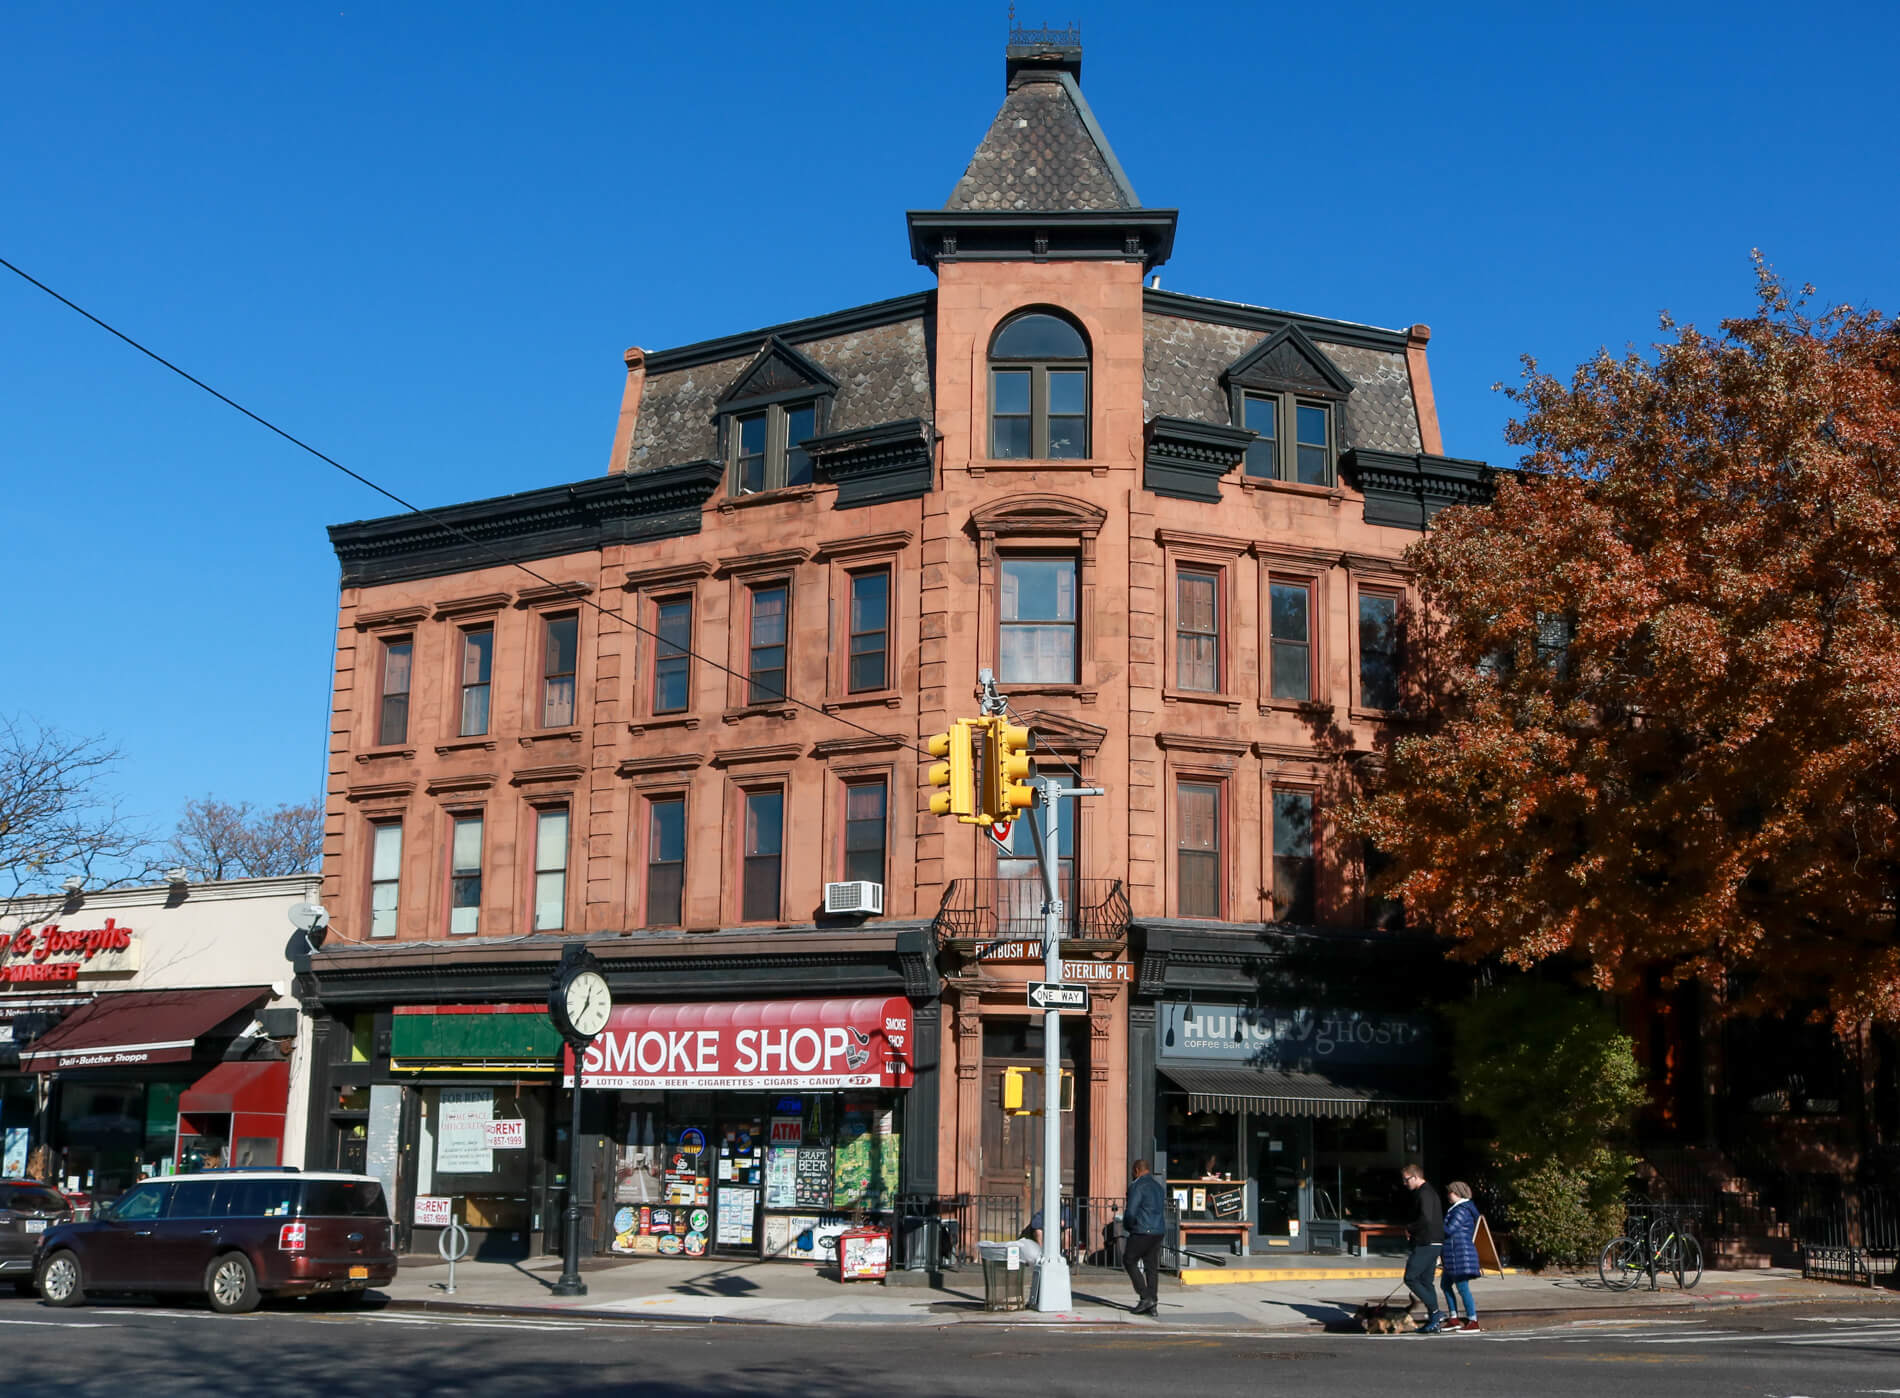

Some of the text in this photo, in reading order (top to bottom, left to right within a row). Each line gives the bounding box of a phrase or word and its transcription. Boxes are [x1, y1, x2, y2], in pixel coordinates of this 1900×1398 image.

[12, 928, 36, 952] &
[34, 918, 132, 960] Josephs
[975, 943, 1023, 959] FLATBUSH
[9, 963, 79, 982] MARKET
[1064, 965, 1130, 980] STERLING PL
[1037, 991, 1080, 1001] ONE WAY
[886, 1018, 907, 1031] SMOKE
[888, 1035, 905, 1048] SHOP
[583, 1028, 849, 1073] SMOKE SHOP
[79, 1055, 112, 1065] Butcher
[114, 1053, 148, 1063] Shoppe
[886, 1061, 906, 1074] LOTTO
[632, 1079, 656, 1087] SODA
[665, 1079, 688, 1087] BEER
[697, 1079, 754, 1087] CIGARETTES
[763, 1078, 799, 1086] CIGARS
[808, 1078, 841, 1086] CANDY
[495, 1123, 522, 1135] RENT
[772, 1123, 801, 1140] ATM
[493, 1136, 522, 1146] 857-1999
[799, 1151, 827, 1160] CRAFT
[798, 1160, 828, 1172] BEER
[425, 1201, 449, 1212] RENT
